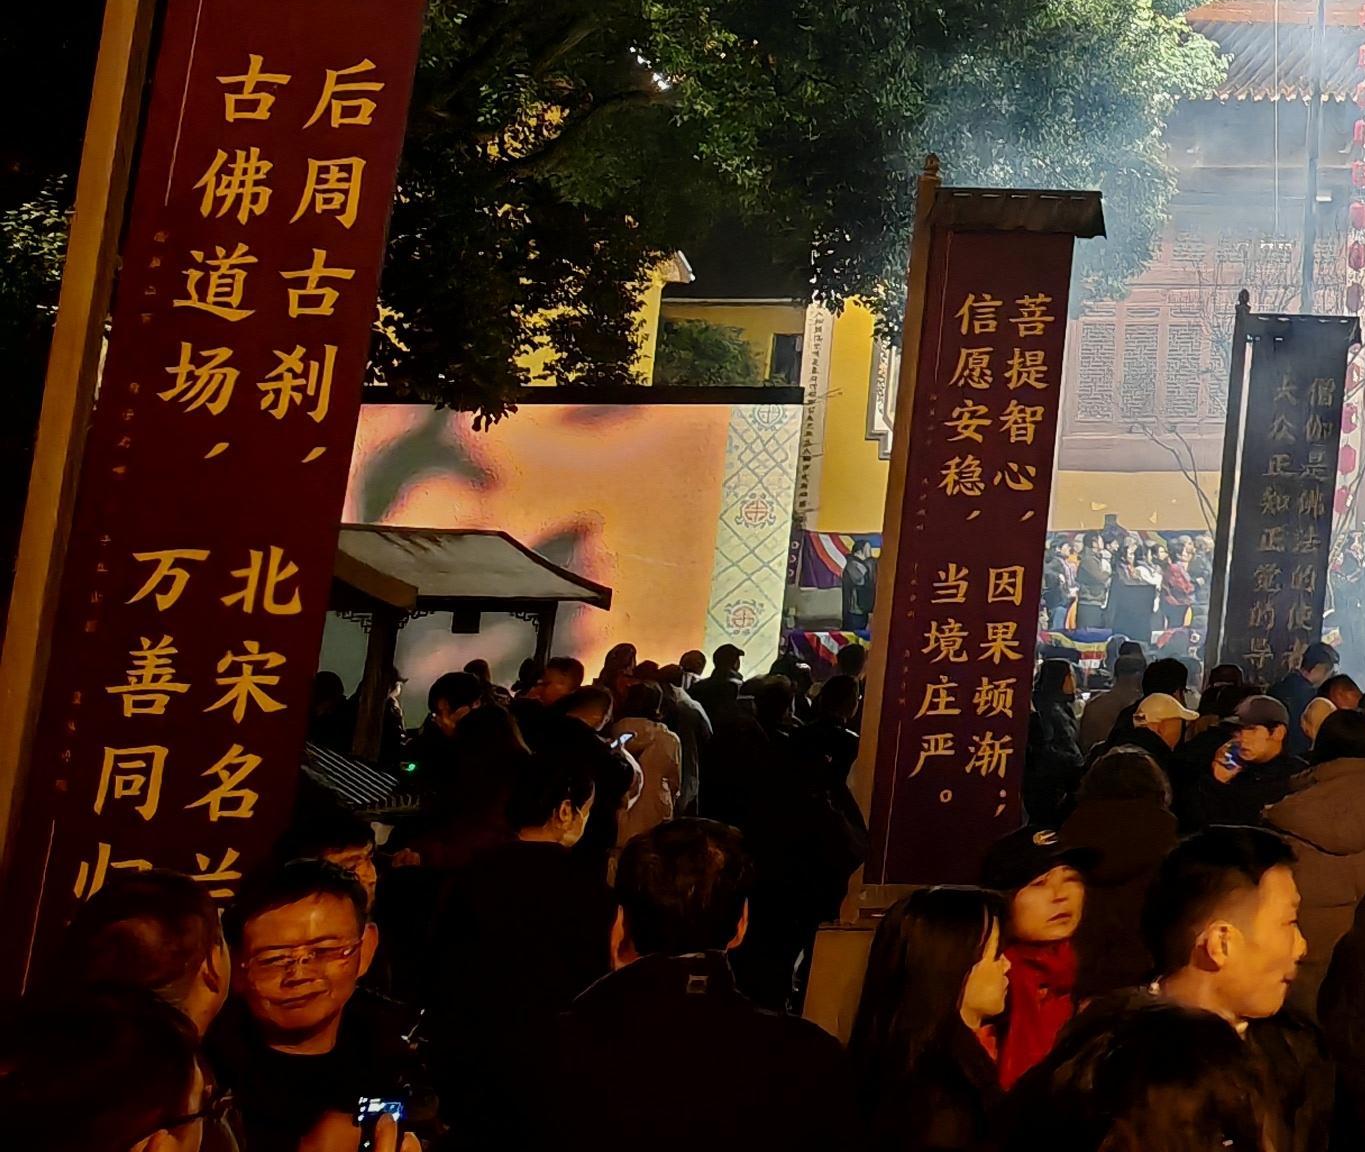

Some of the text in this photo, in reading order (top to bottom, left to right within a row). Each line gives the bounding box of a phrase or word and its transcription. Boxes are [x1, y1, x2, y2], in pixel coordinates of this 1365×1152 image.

[157, 55, 291, 462] 古佛道场，
[256, 61, 385, 462] 后周古刹，
[908, 293, 1004, 806] 信愿安稳， 当境庄严。
[965, 293, 1056, 818] 菩提智心， 因果顿渐；
